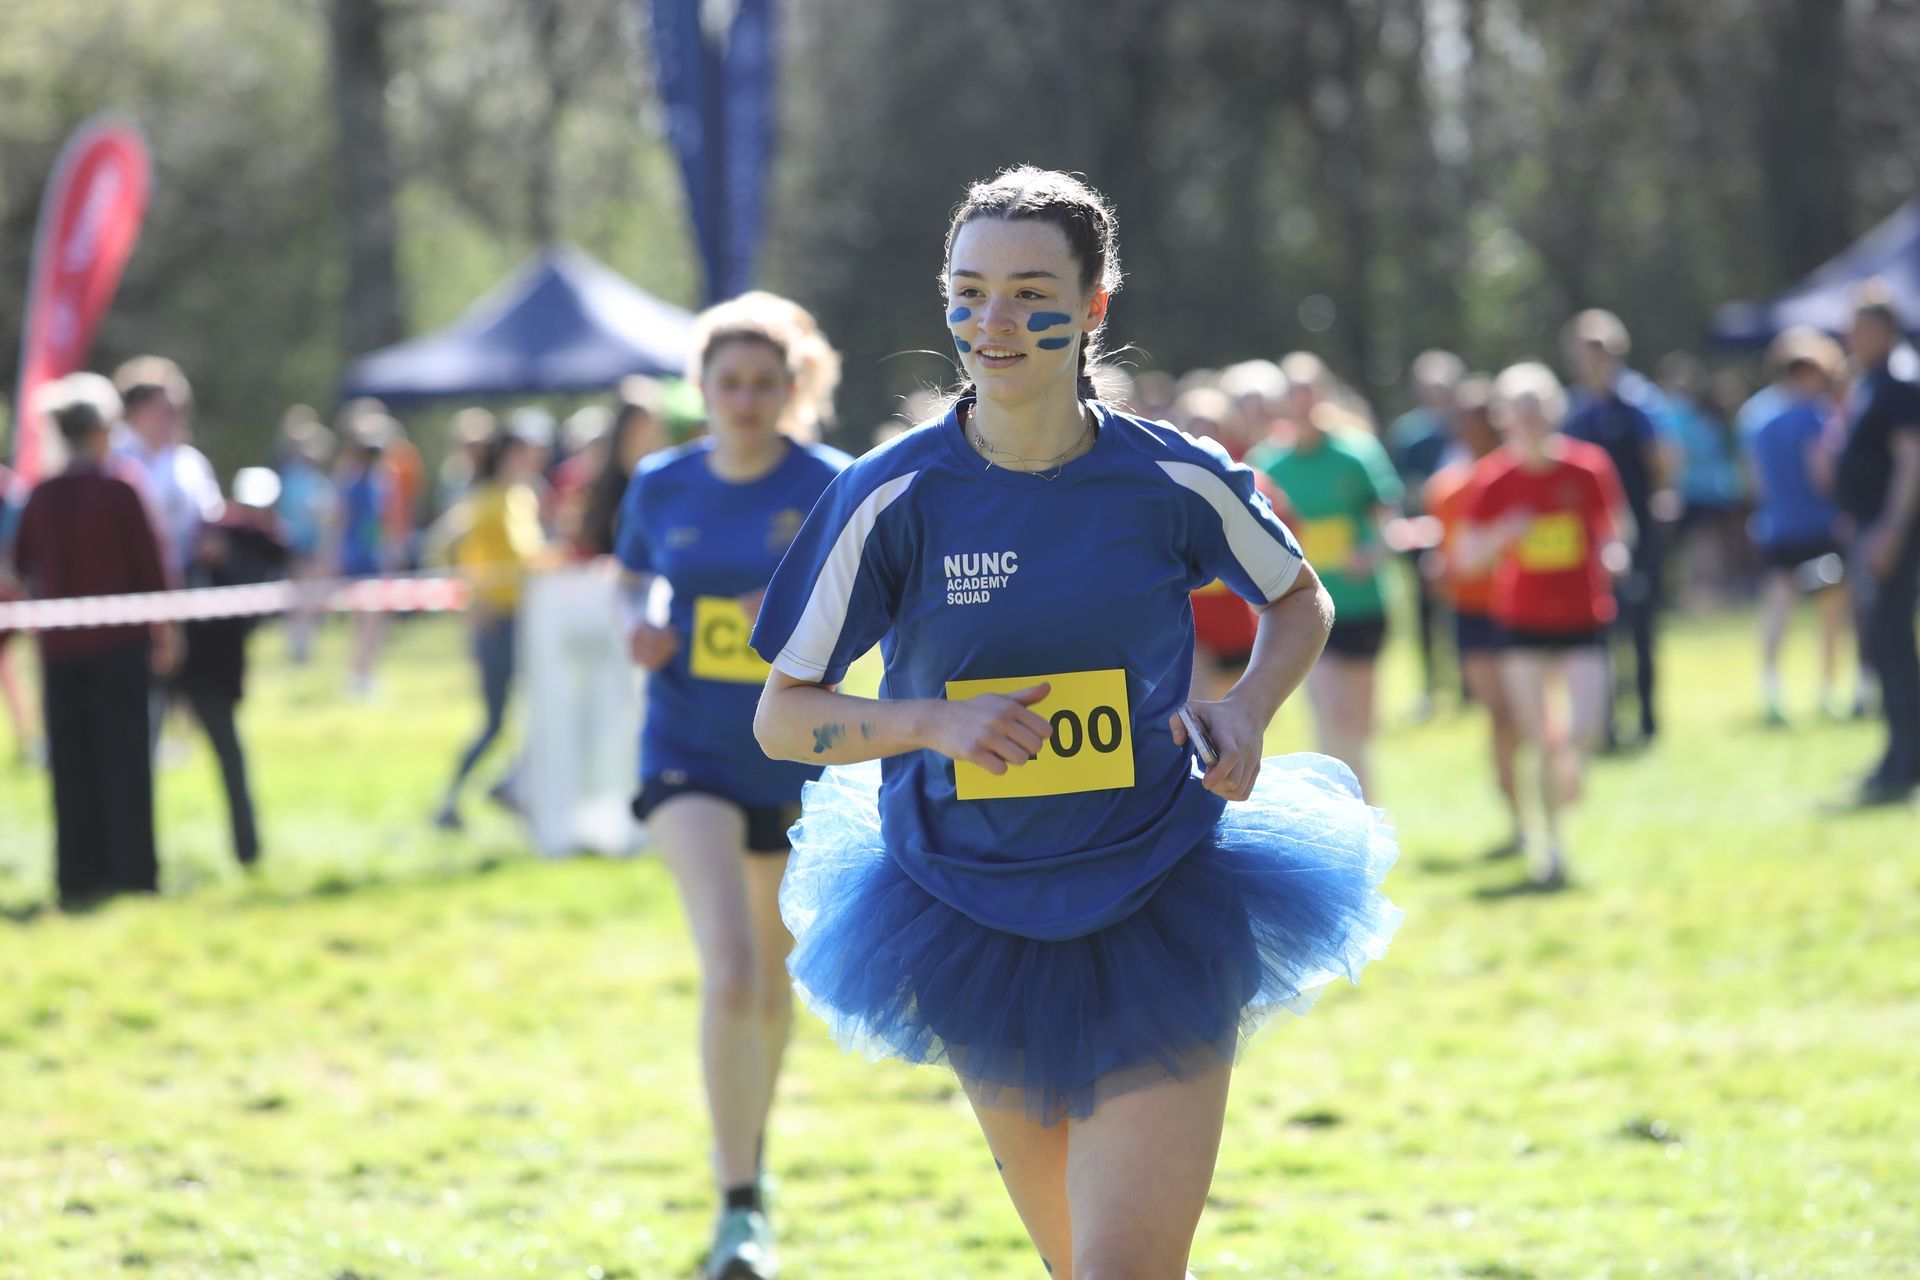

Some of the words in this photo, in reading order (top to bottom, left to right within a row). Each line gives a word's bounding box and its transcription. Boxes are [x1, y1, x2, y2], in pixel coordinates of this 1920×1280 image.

[944, 550, 1019, 577] NUNC
[947, 575, 1009, 592] ACADEMY
[946, 591, 991, 605] SQUAD
[703, 616, 761, 664] C
[1027, 705, 1123, 761] 00
